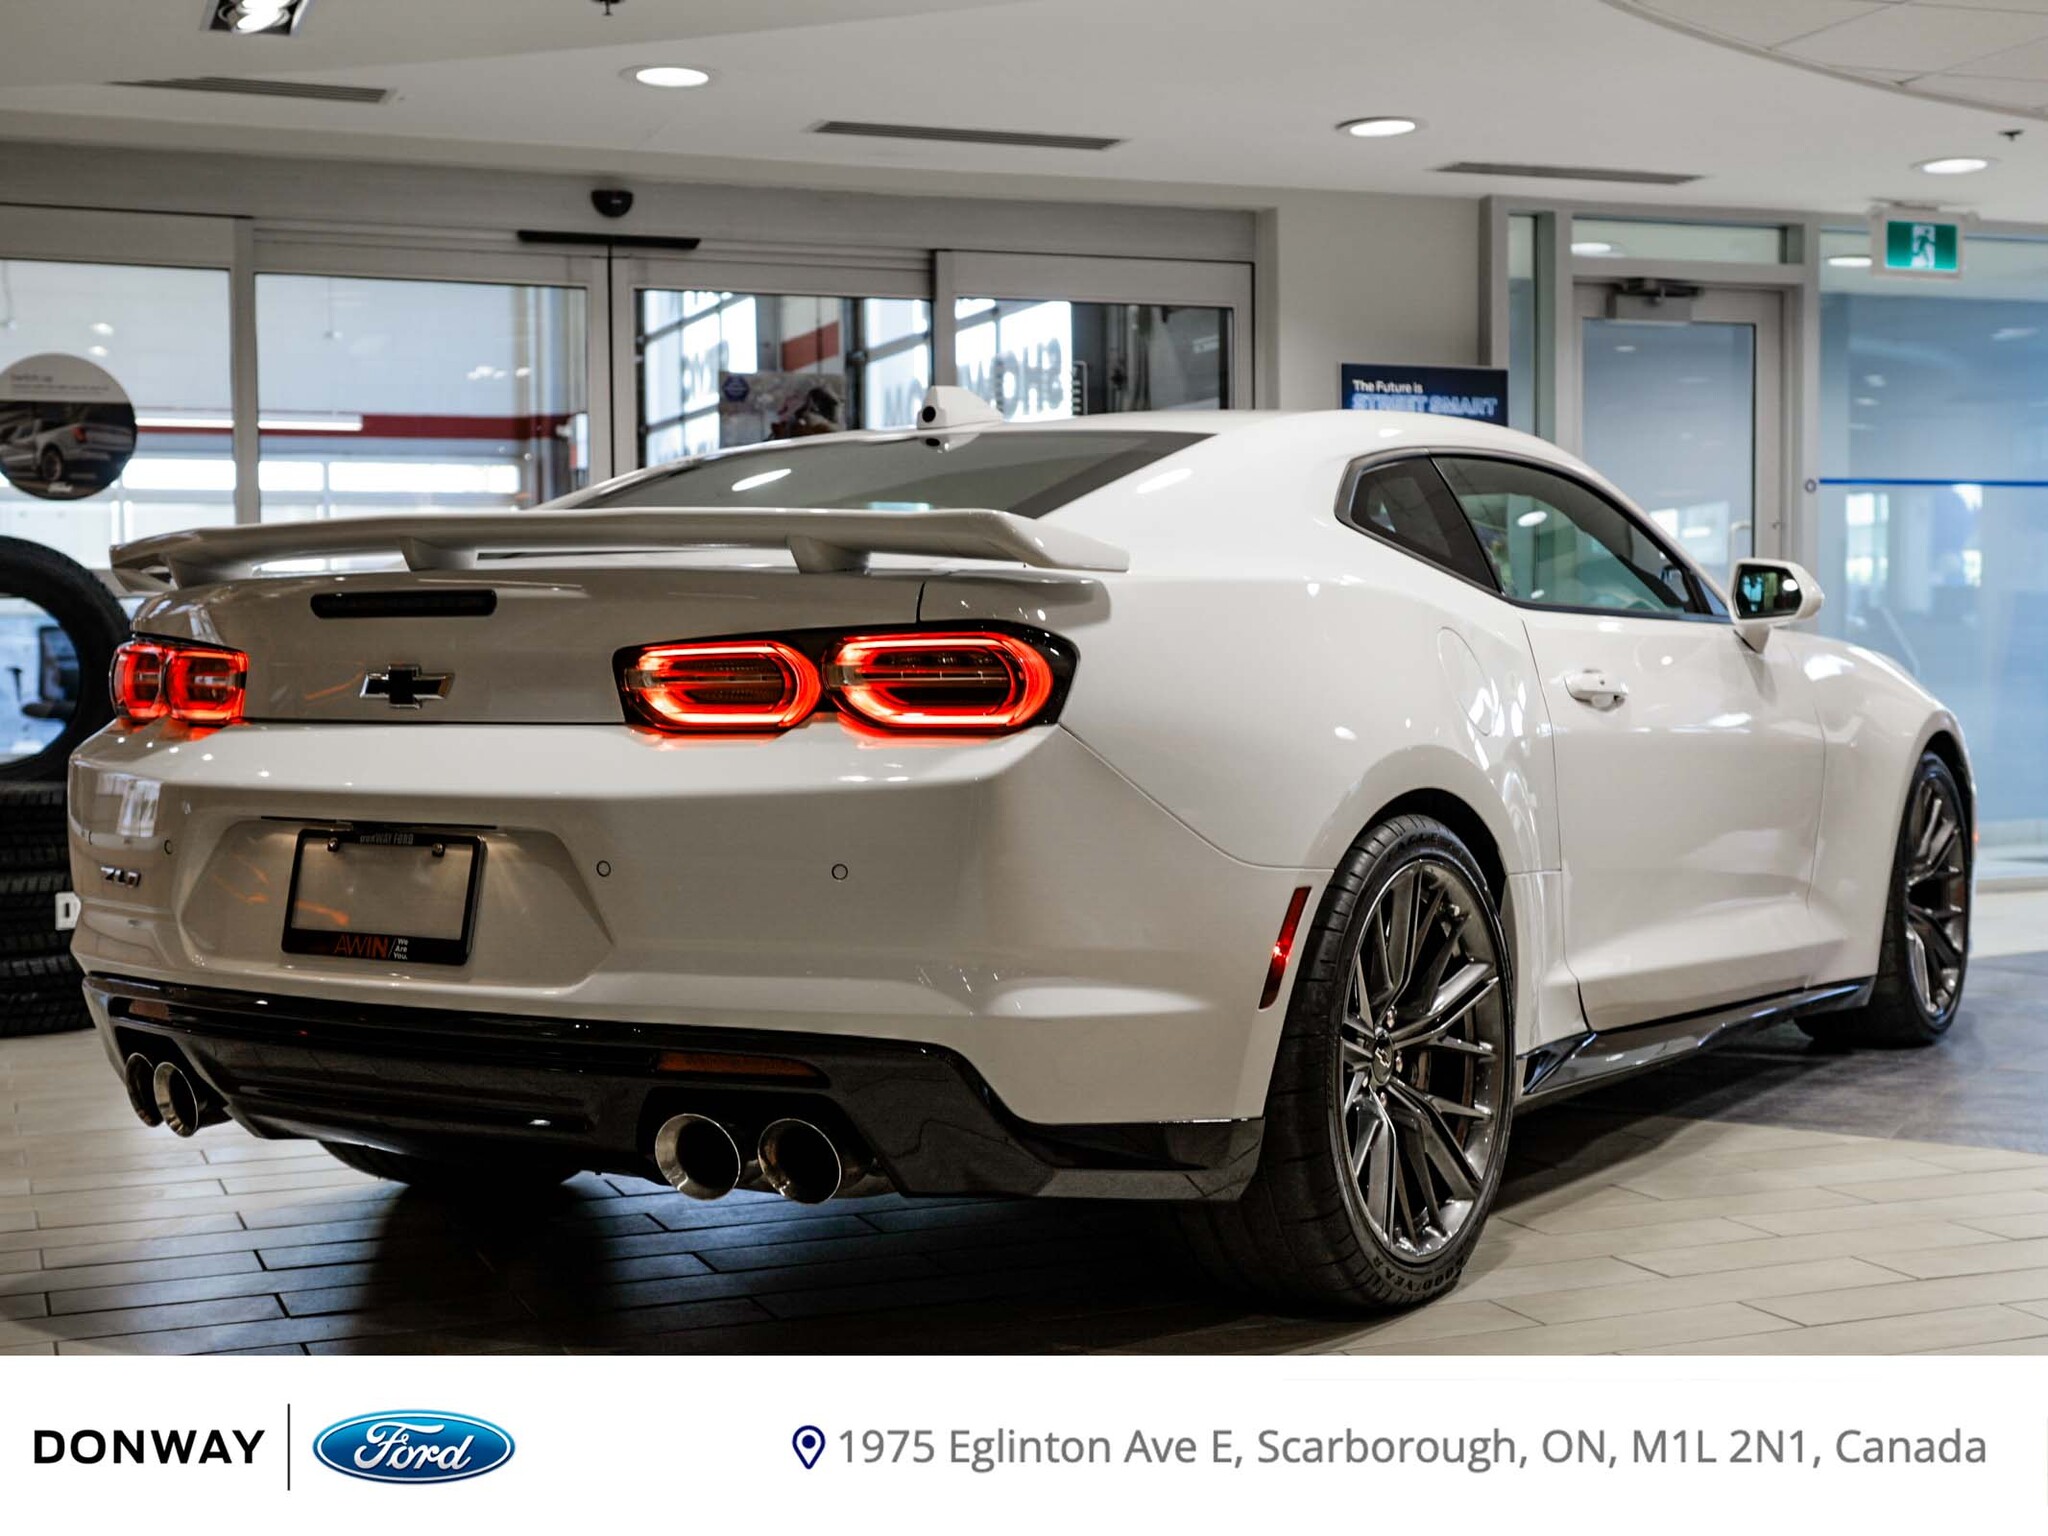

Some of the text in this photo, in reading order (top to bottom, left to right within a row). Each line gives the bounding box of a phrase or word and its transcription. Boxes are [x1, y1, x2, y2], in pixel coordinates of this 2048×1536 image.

[1352, 379, 1424, 394] The Future is
[1428, 394, 1499, 416] SMART
[334, 934, 389, 958] AWIN
[394, 945, 408, 953] Are
[397, 938, 409, 946] We
